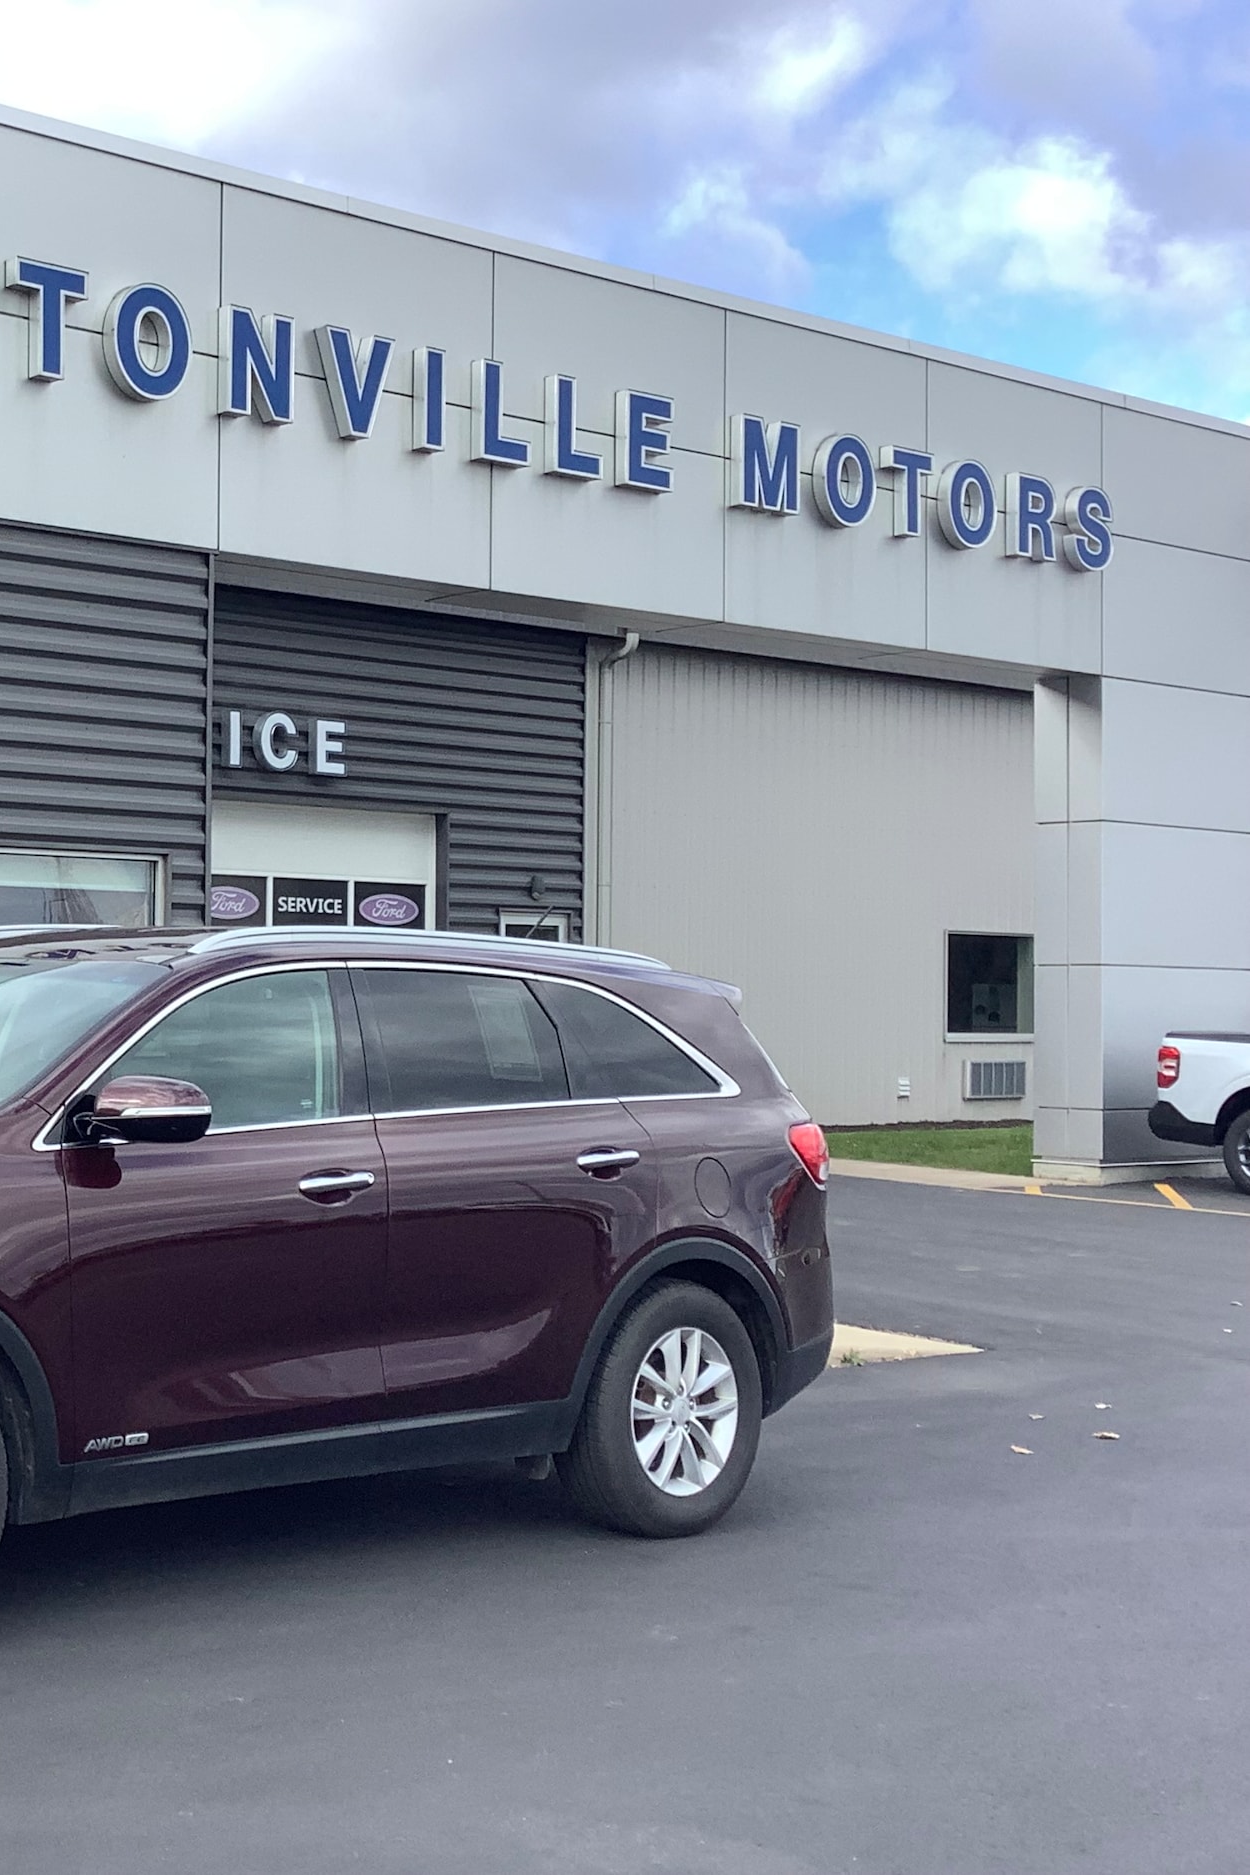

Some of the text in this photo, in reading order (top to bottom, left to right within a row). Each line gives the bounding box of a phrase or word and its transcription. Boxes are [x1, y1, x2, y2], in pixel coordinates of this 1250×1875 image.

[730, 413, 1114, 573] MOTORS
[222, 709, 347, 778] ICE
[211, 891, 246, 913] Ford
[277, 896, 343, 915] SERVICE
[371, 899, 406, 919] Ford
[83, 1435, 124, 1453] AWD
